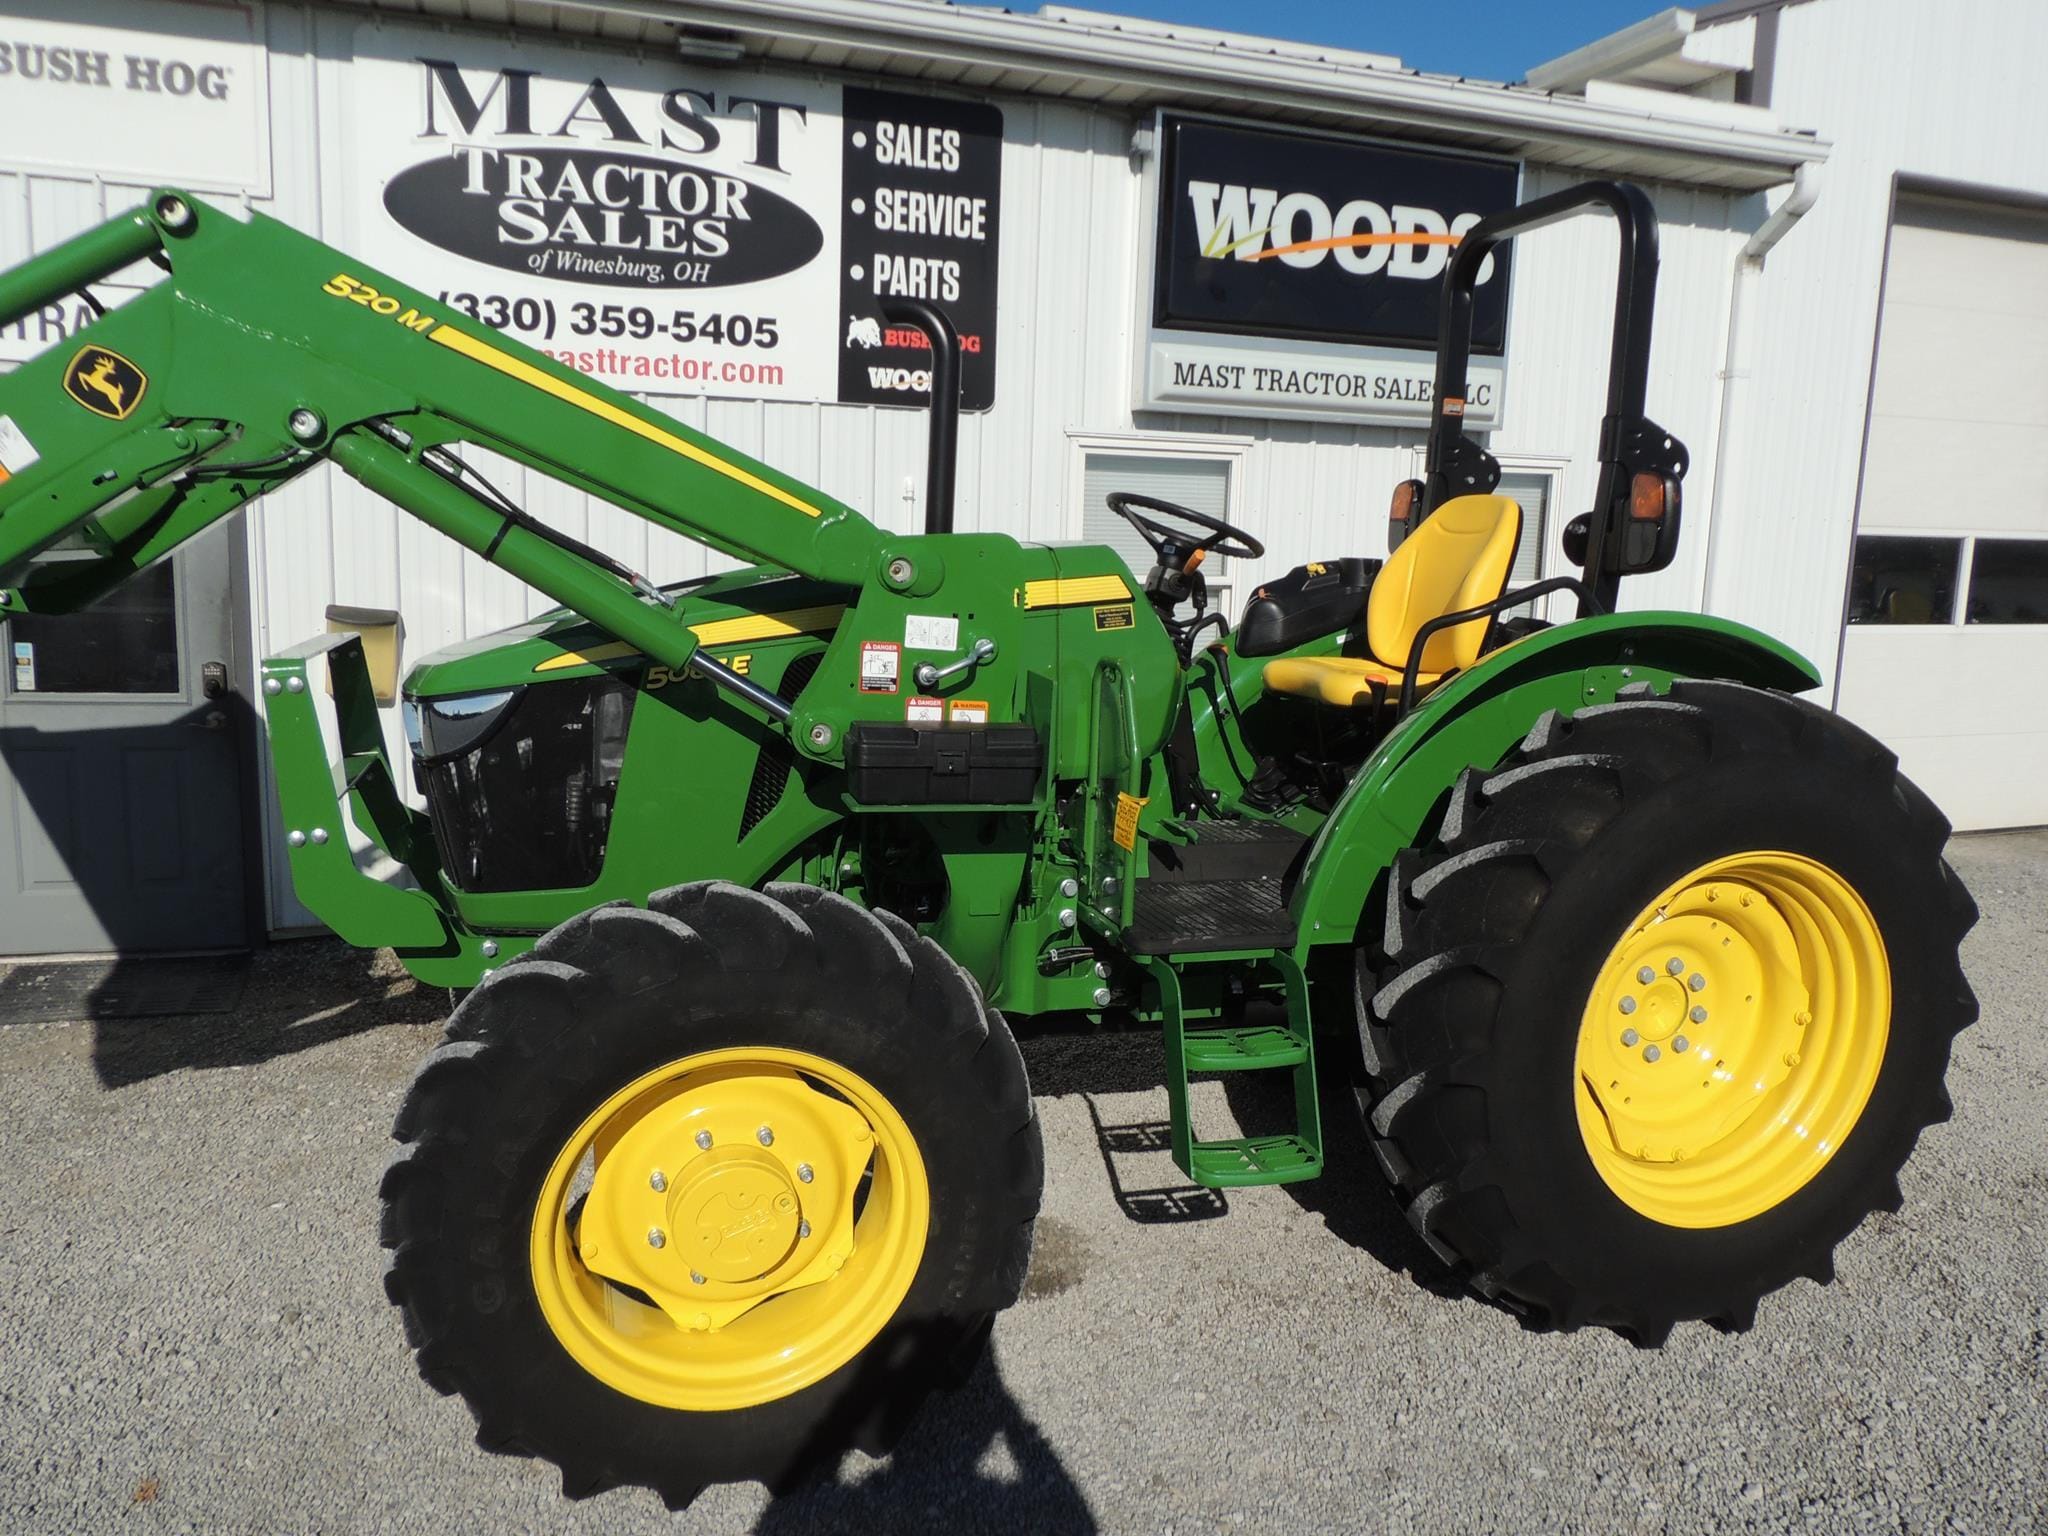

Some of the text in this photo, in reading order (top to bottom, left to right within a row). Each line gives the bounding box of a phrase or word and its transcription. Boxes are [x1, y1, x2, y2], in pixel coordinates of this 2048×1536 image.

[124, 54, 229, 101] HOG
[414, 56, 807, 176] MAST
[875, 121, 960, 172] SALES
[452, 143, 751, 221] TRACTOR
[498, 199, 730, 258] SALES
[874, 187, 986, 240] SERVICE
[528, 249, 711, 283] of Winesburg, OH
[873, 253, 960, 301] PARTS
[322, 272, 437, 333] 520 M
[571, 303, 779, 350] 359-5405
[957, 334, 981, 353] OG
[867, 366, 932, 393] WOO
[1173, 362, 1492, 406] MAST TRACTOR SALE LC
